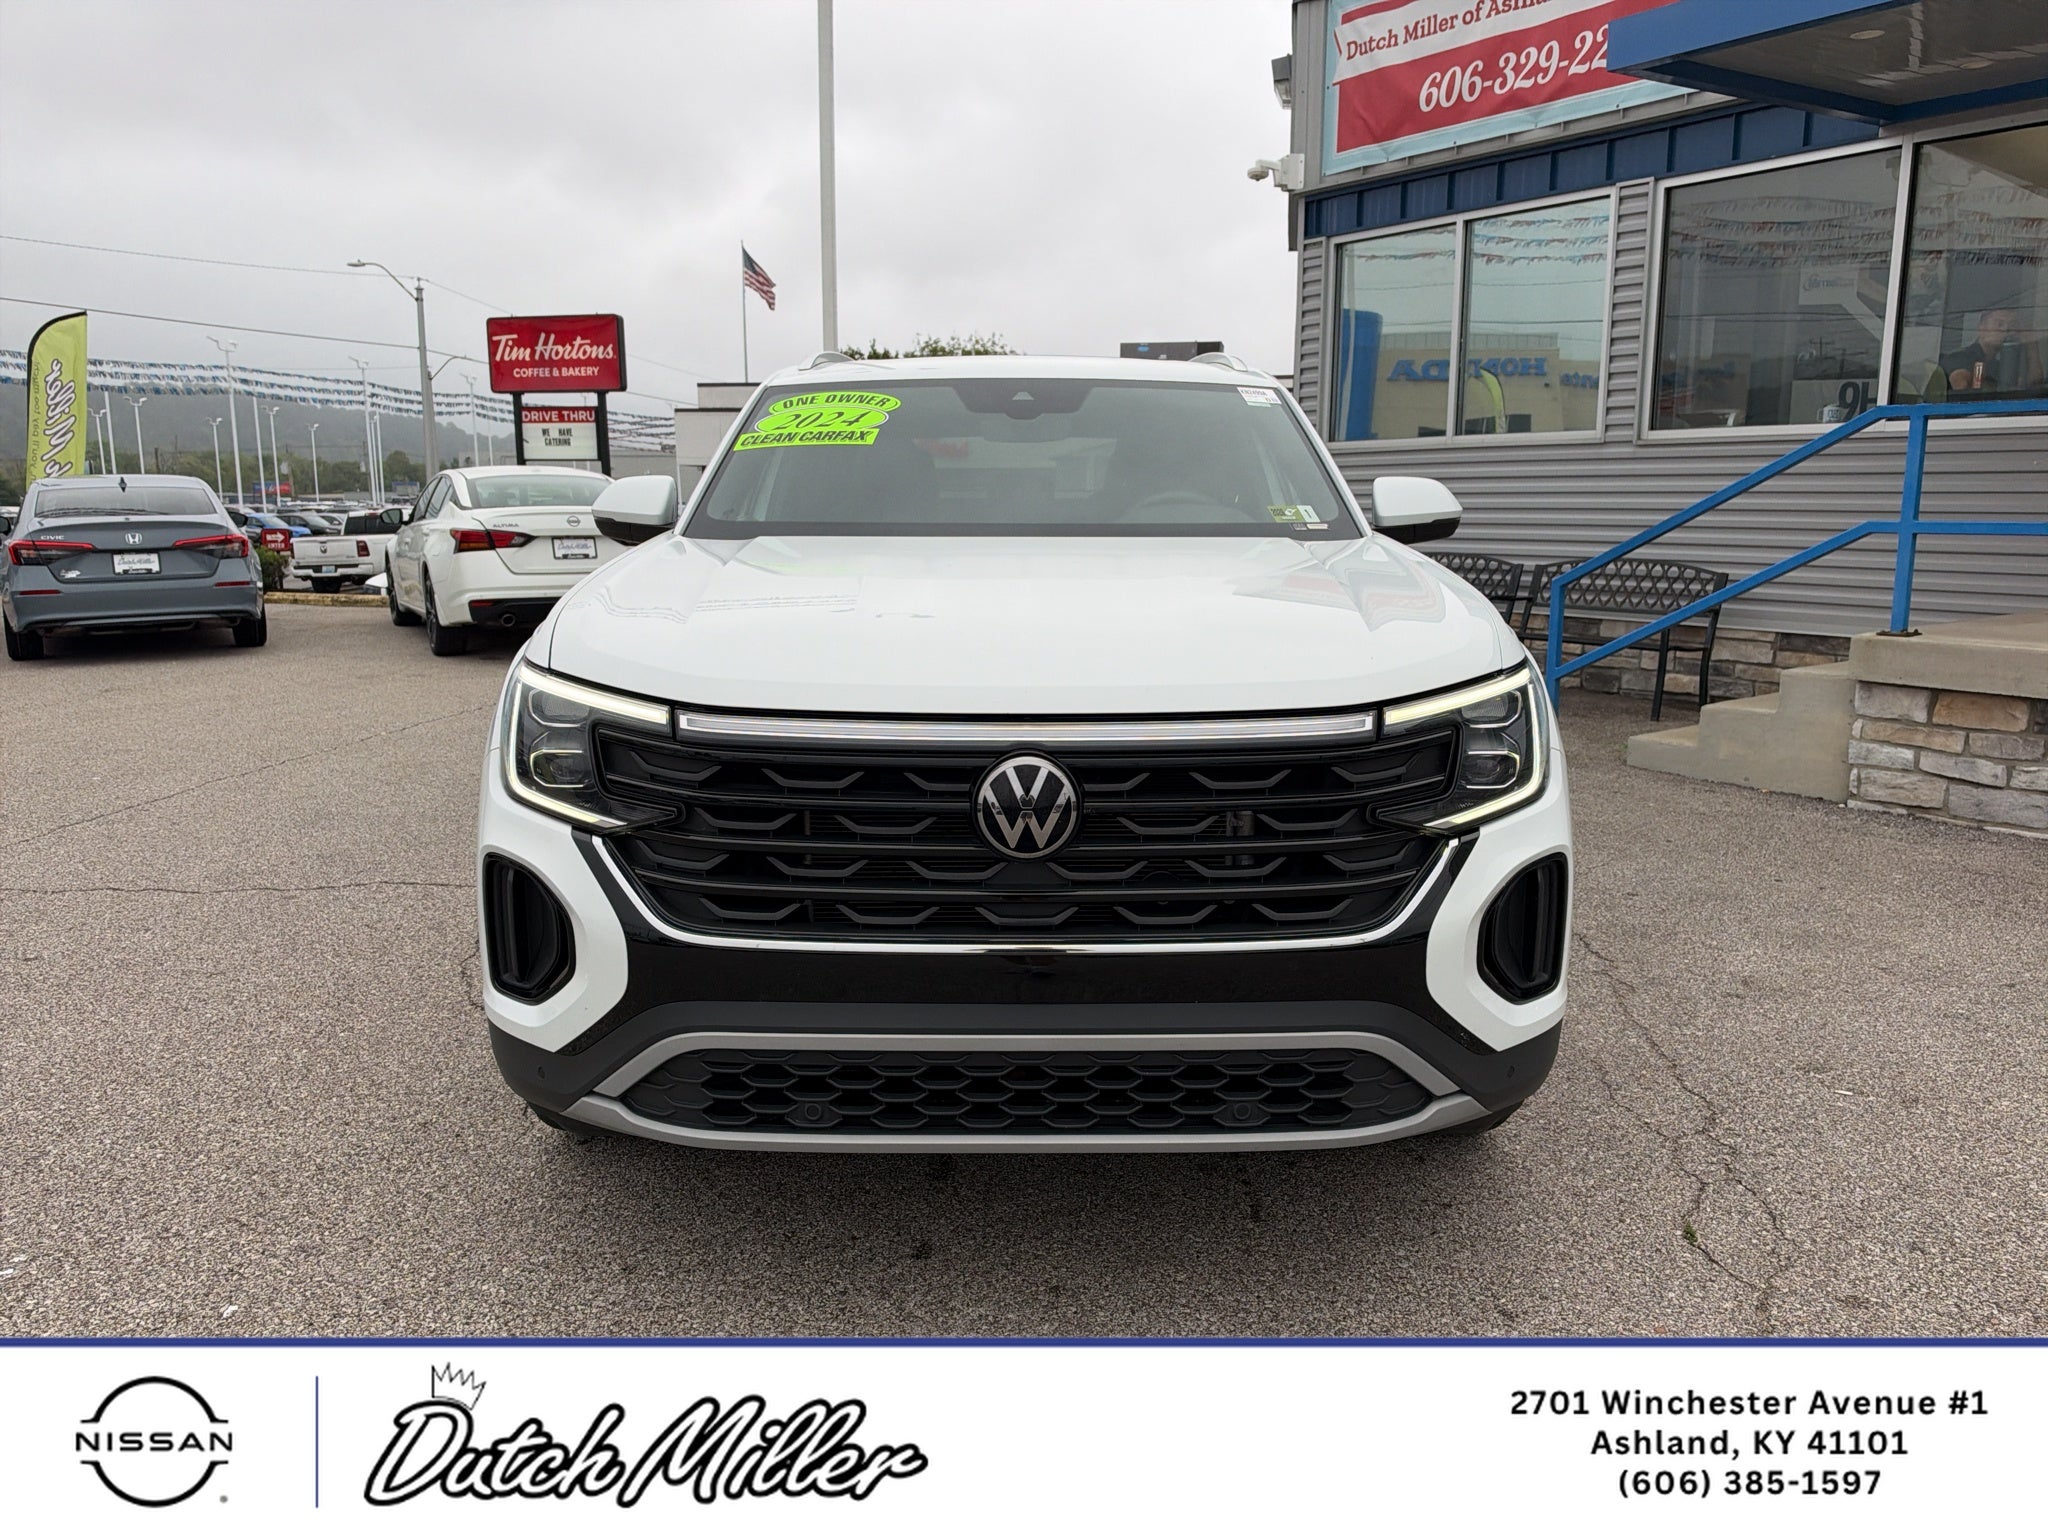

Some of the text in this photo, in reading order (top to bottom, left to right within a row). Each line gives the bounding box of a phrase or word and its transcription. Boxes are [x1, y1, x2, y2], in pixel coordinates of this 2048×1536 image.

[1346, 29, 1399, 60] Dutch
[1402, 14, 1460, 45] Miller
[1462, 0, 1483, 25] of
[492, 332, 614, 362] Tim Hortons
[513, 366, 600, 378] COFFEE & BAKERY
[783, 393, 892, 410] ONE OWNER
[521, 410, 596, 422] DRIVE THRU
[772, 410, 872, 430] 2024
[541, 428, 573, 437] WE HAVE
[740, 430, 874, 447] CLEAN CARFAX
[544, 437, 572, 447] CATERING
